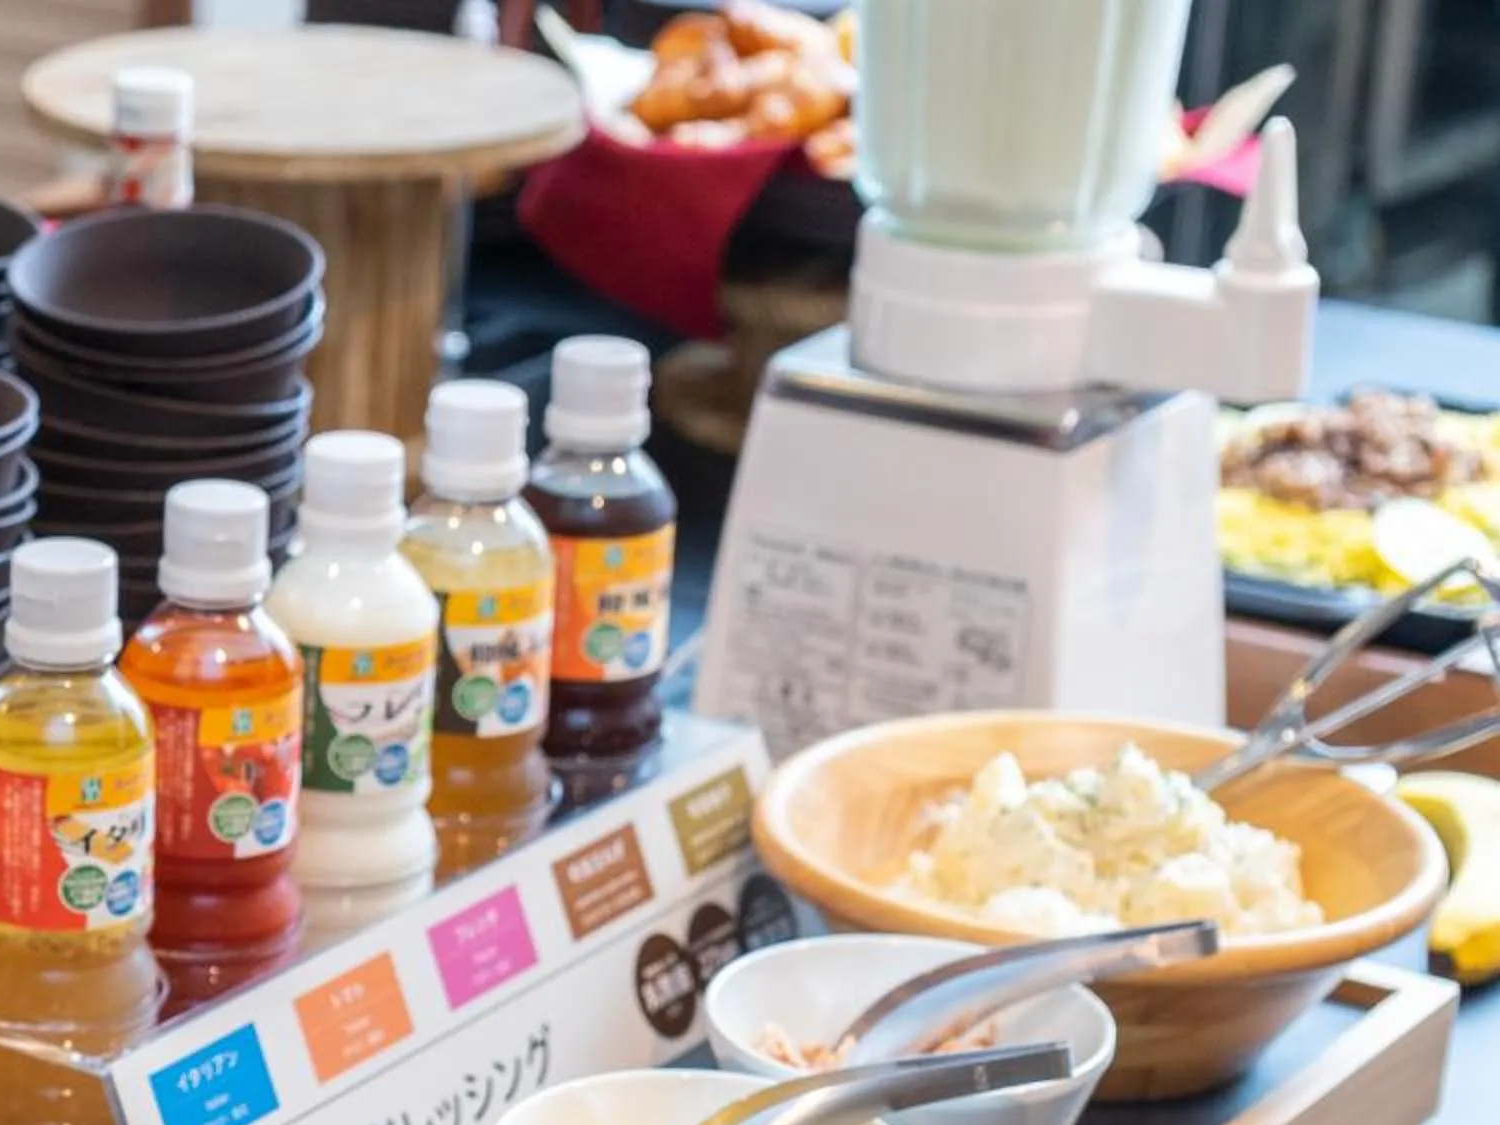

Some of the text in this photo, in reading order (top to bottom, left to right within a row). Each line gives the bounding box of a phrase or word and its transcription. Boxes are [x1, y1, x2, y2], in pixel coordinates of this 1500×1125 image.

[176, 1050, 239, 1093] イタリアン
